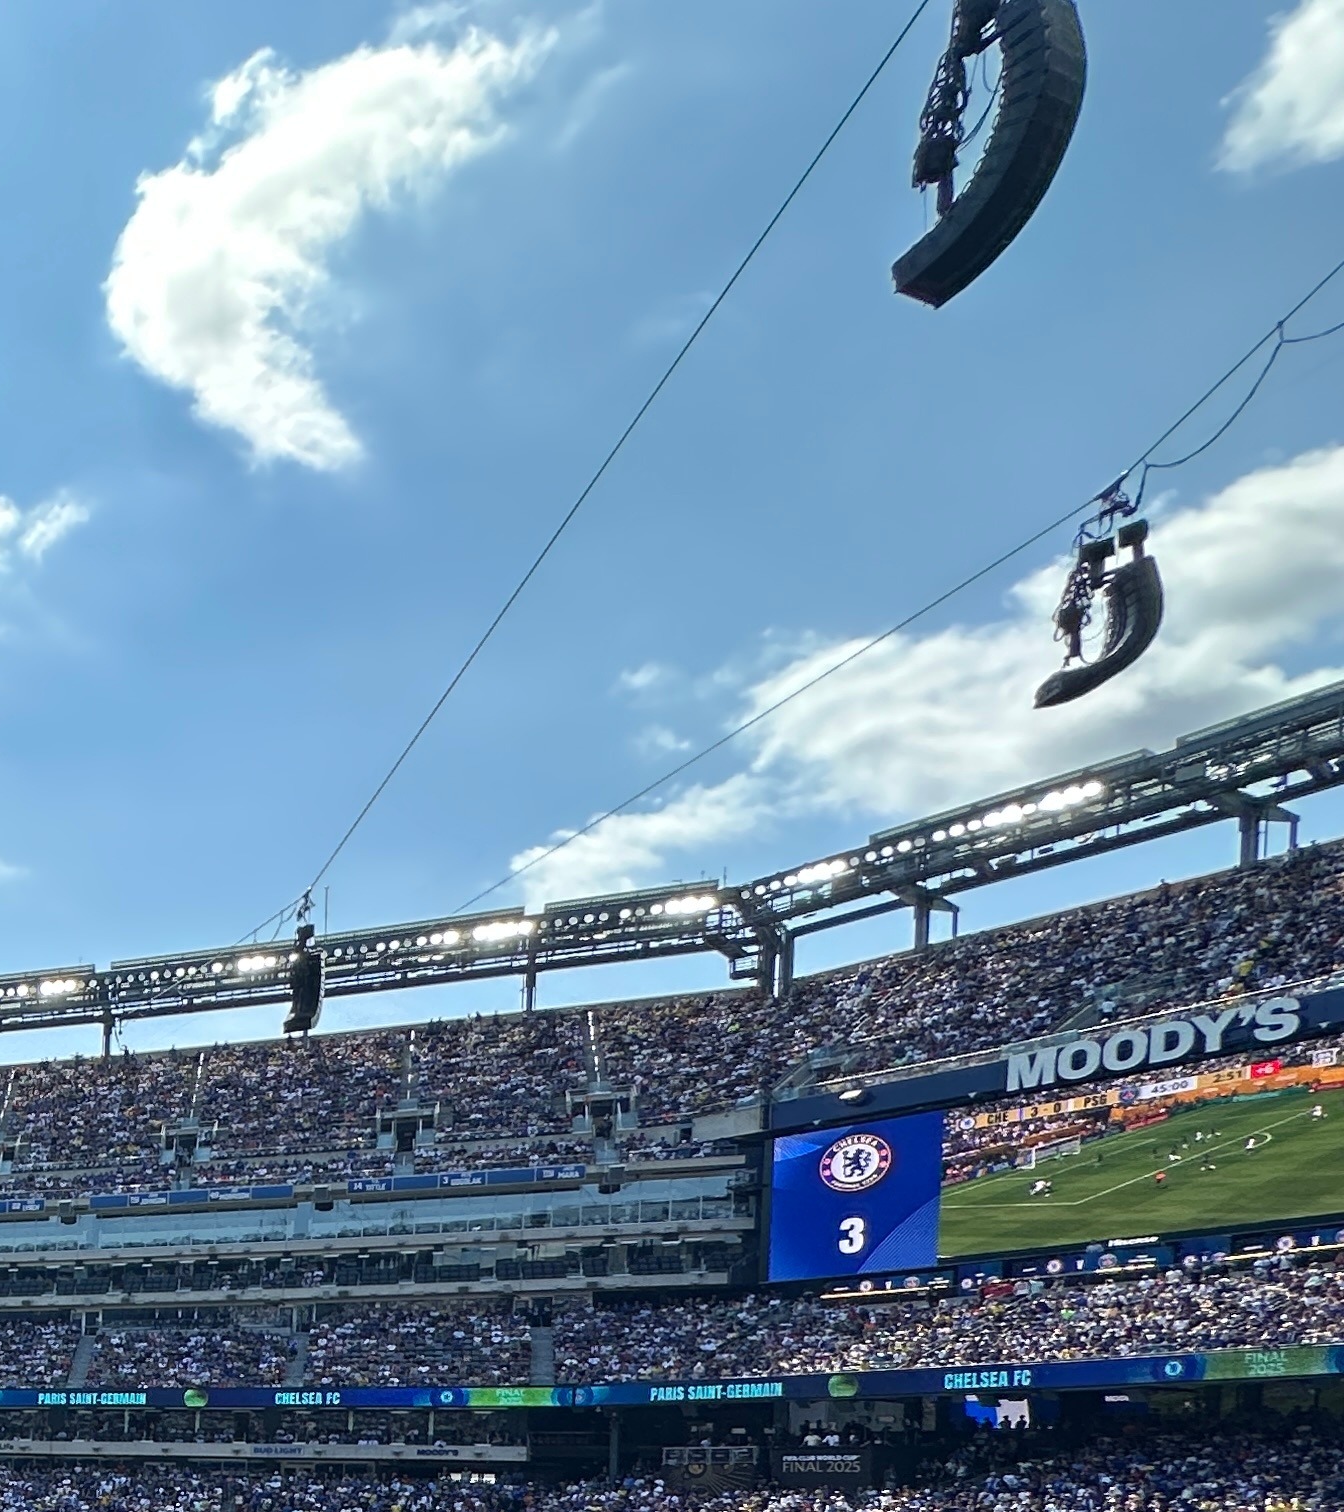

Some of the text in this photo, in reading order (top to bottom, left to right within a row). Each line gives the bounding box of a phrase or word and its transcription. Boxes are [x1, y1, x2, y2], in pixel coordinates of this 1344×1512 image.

[1006, 997, 1301, 1092] MOODY'S
[1151, 1080, 1189, 1094] 45:00
[1212, 1070, 1243, 1083] 2:51
[986, 1111, 1009, 1124] CHE
[1083, 1093, 1108, 1107] PSG
[839, 1217, 865, 1254] 3
[1244, 1350, 1288, 1364] FINAL
[944, 1369, 1032, 1389] CHELSEA FC
[37, 1392, 147, 1405] PARIS SAINT-GERMAIN
[274, 1392, 341, 1405] CHELSEA FC
[649, 1382, 783, 1401] PARIS SAINT-GERMAIN
[782, 1460, 861, 1473] FINAL 2025
